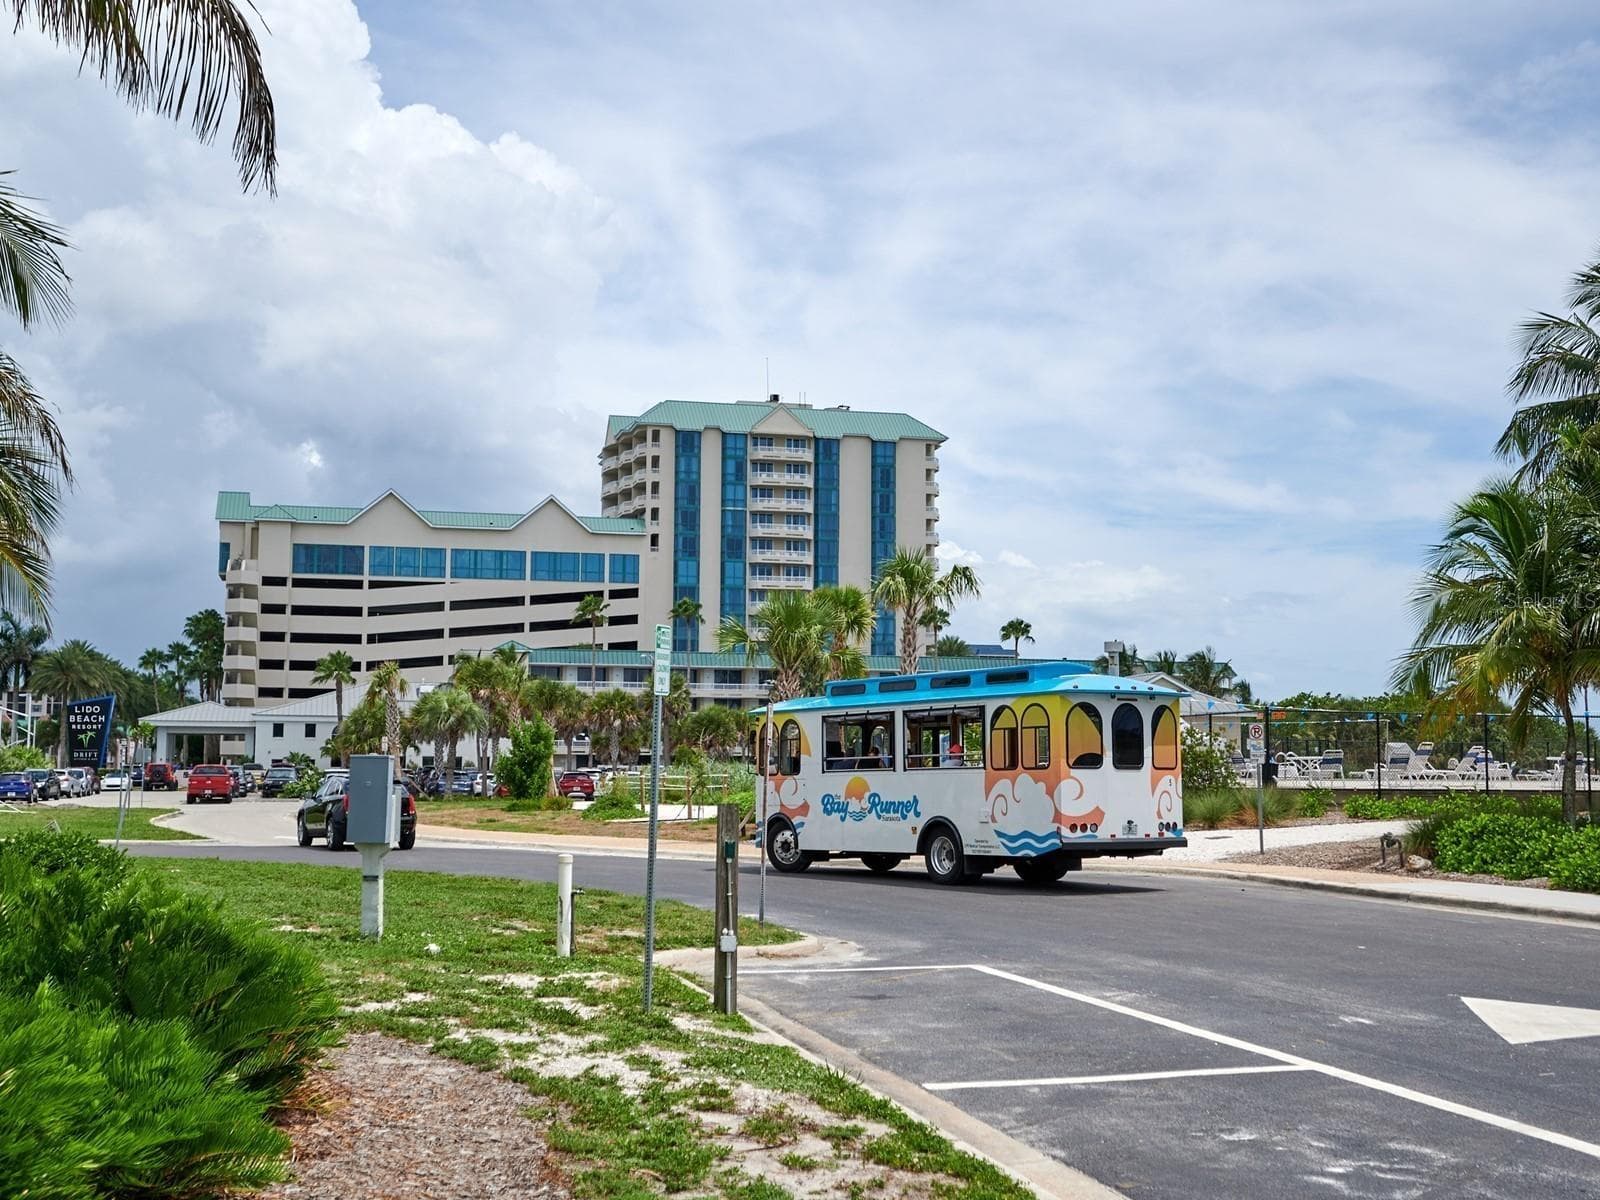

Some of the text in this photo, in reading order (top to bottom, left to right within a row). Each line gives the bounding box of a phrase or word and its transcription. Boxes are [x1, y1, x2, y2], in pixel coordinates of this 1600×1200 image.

[74, 705, 101, 713] LIDO
[821, 792, 921, 822] Bay Runner
[881, 814, 901, 822] Sarasota
